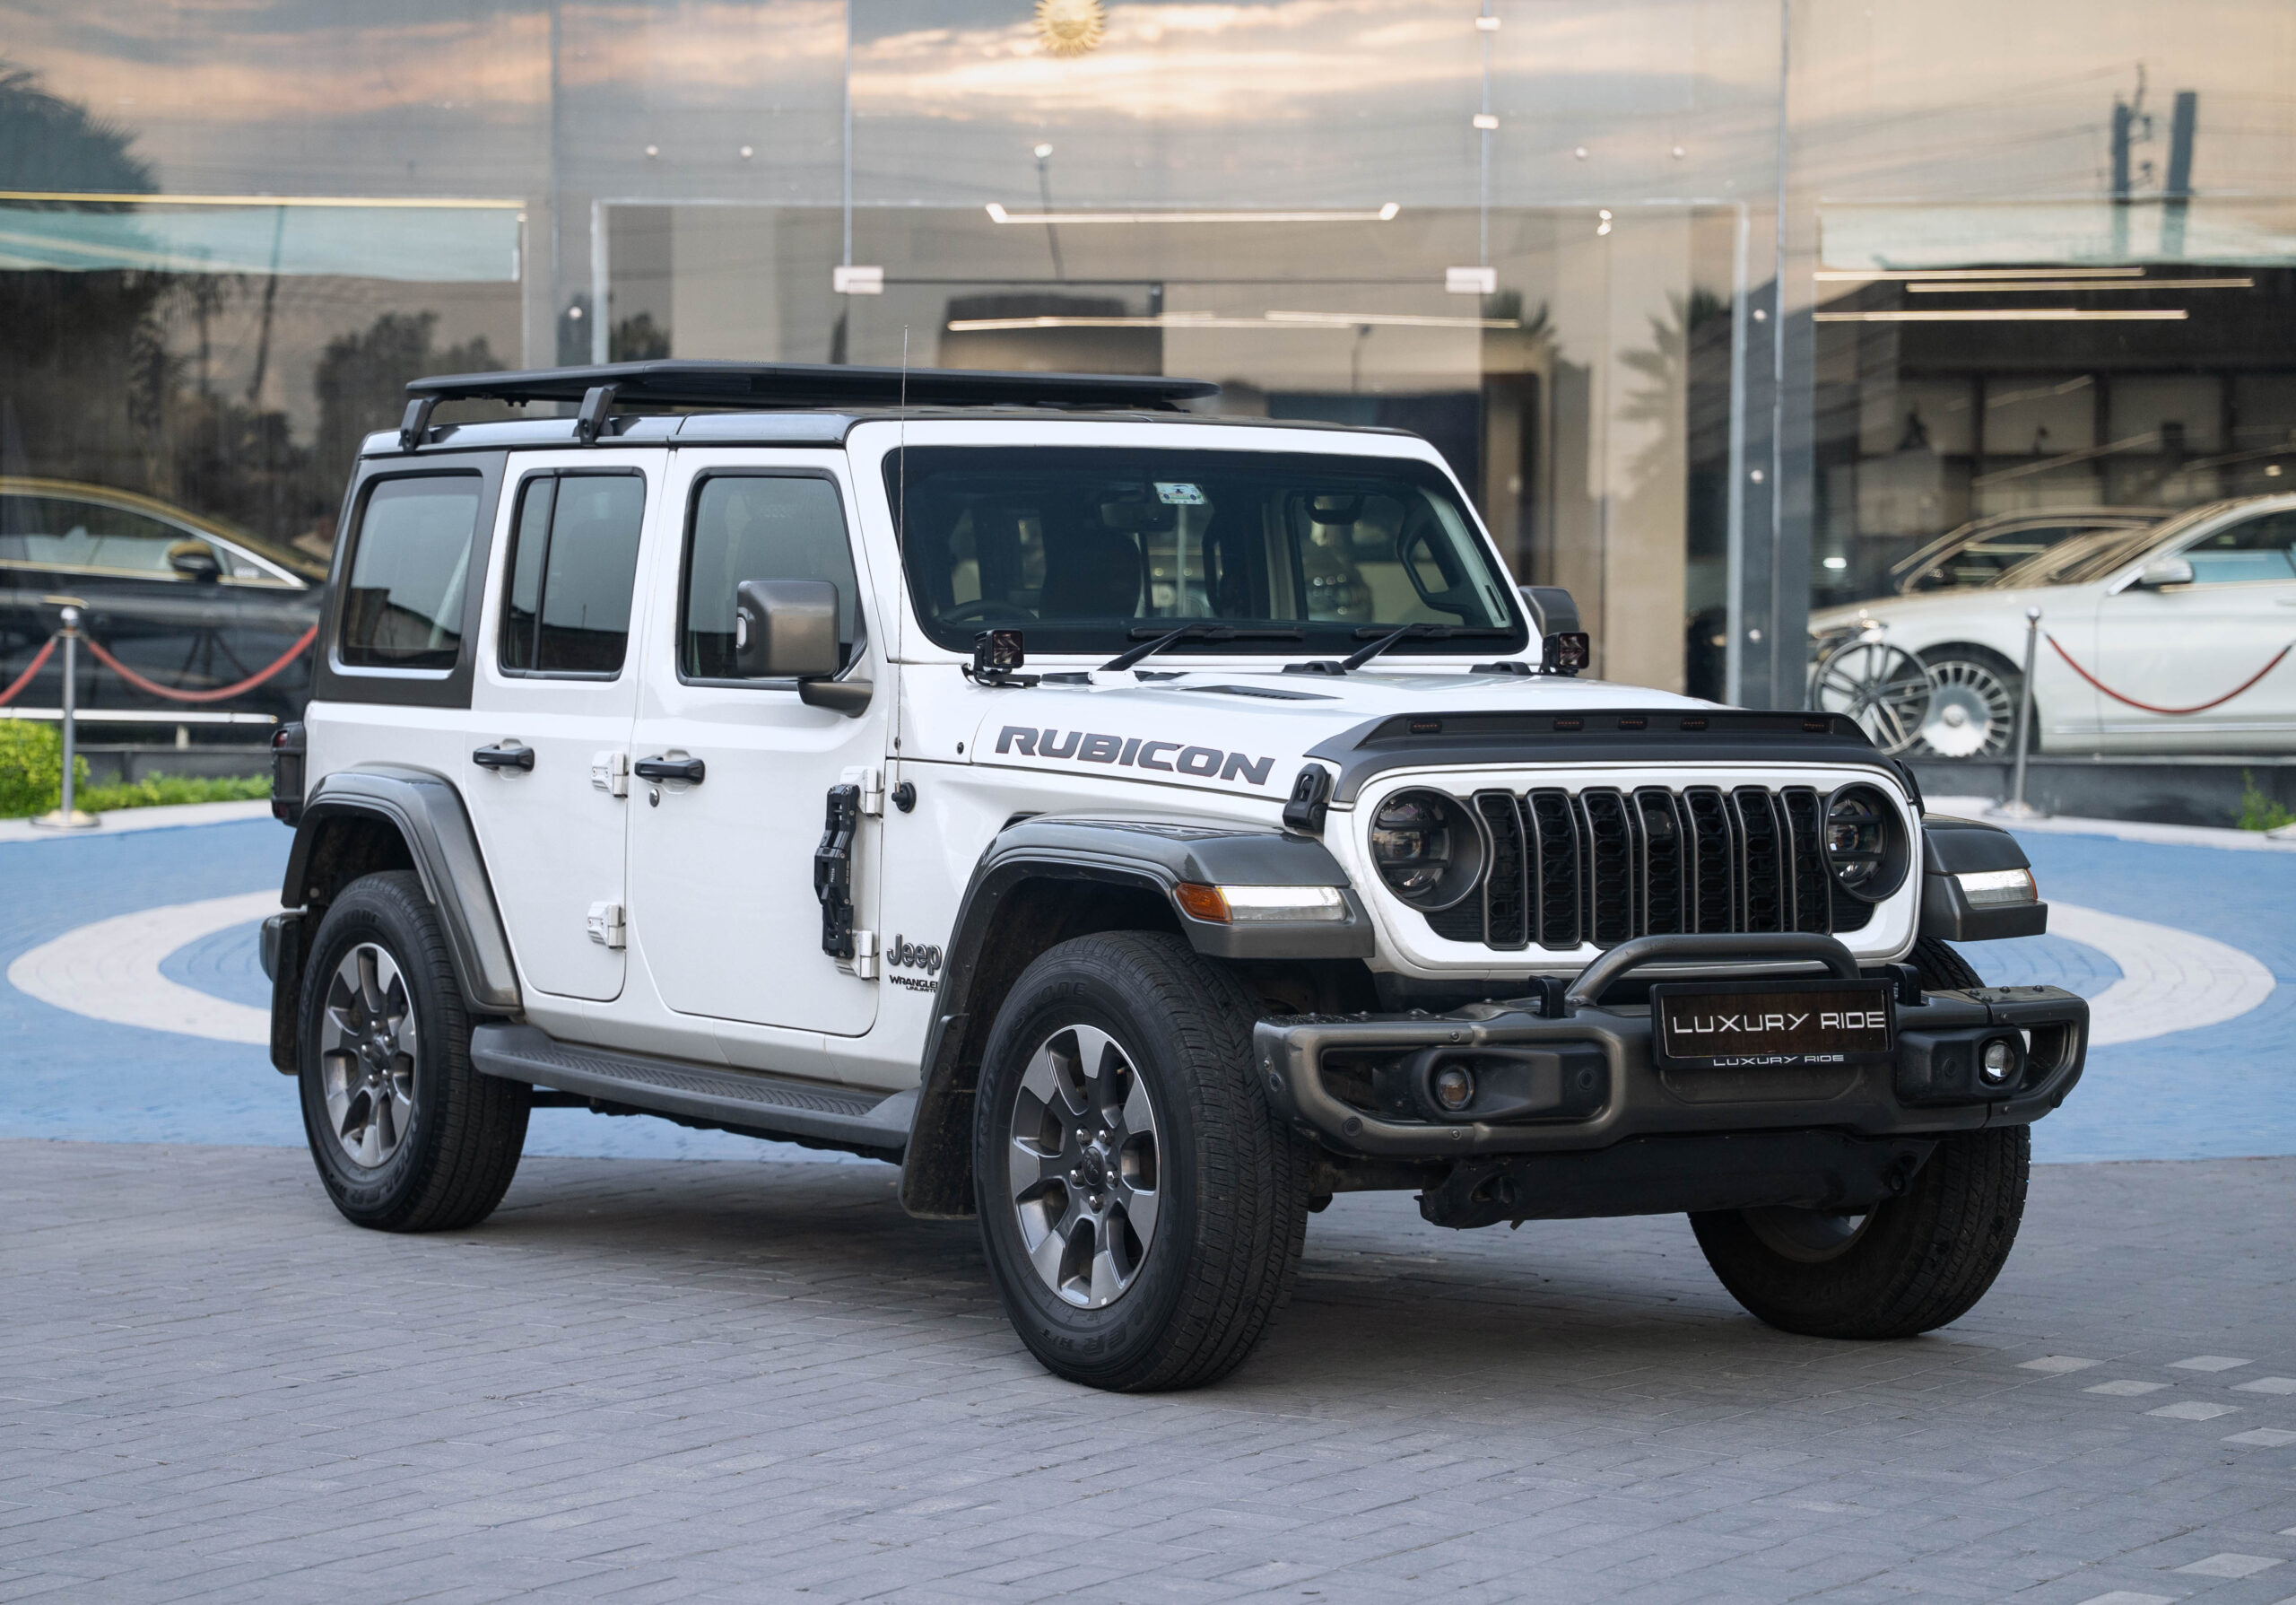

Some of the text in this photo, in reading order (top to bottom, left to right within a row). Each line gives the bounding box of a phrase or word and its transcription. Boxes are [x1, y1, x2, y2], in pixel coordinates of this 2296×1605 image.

[995, 725, 1275, 786] RUBICON
[886, 933, 943, 976] Jeep
[1673, 1011, 1885, 1034] LUXURY RIDE
[1713, 1054, 1845, 1067] LUXURY RIDE
